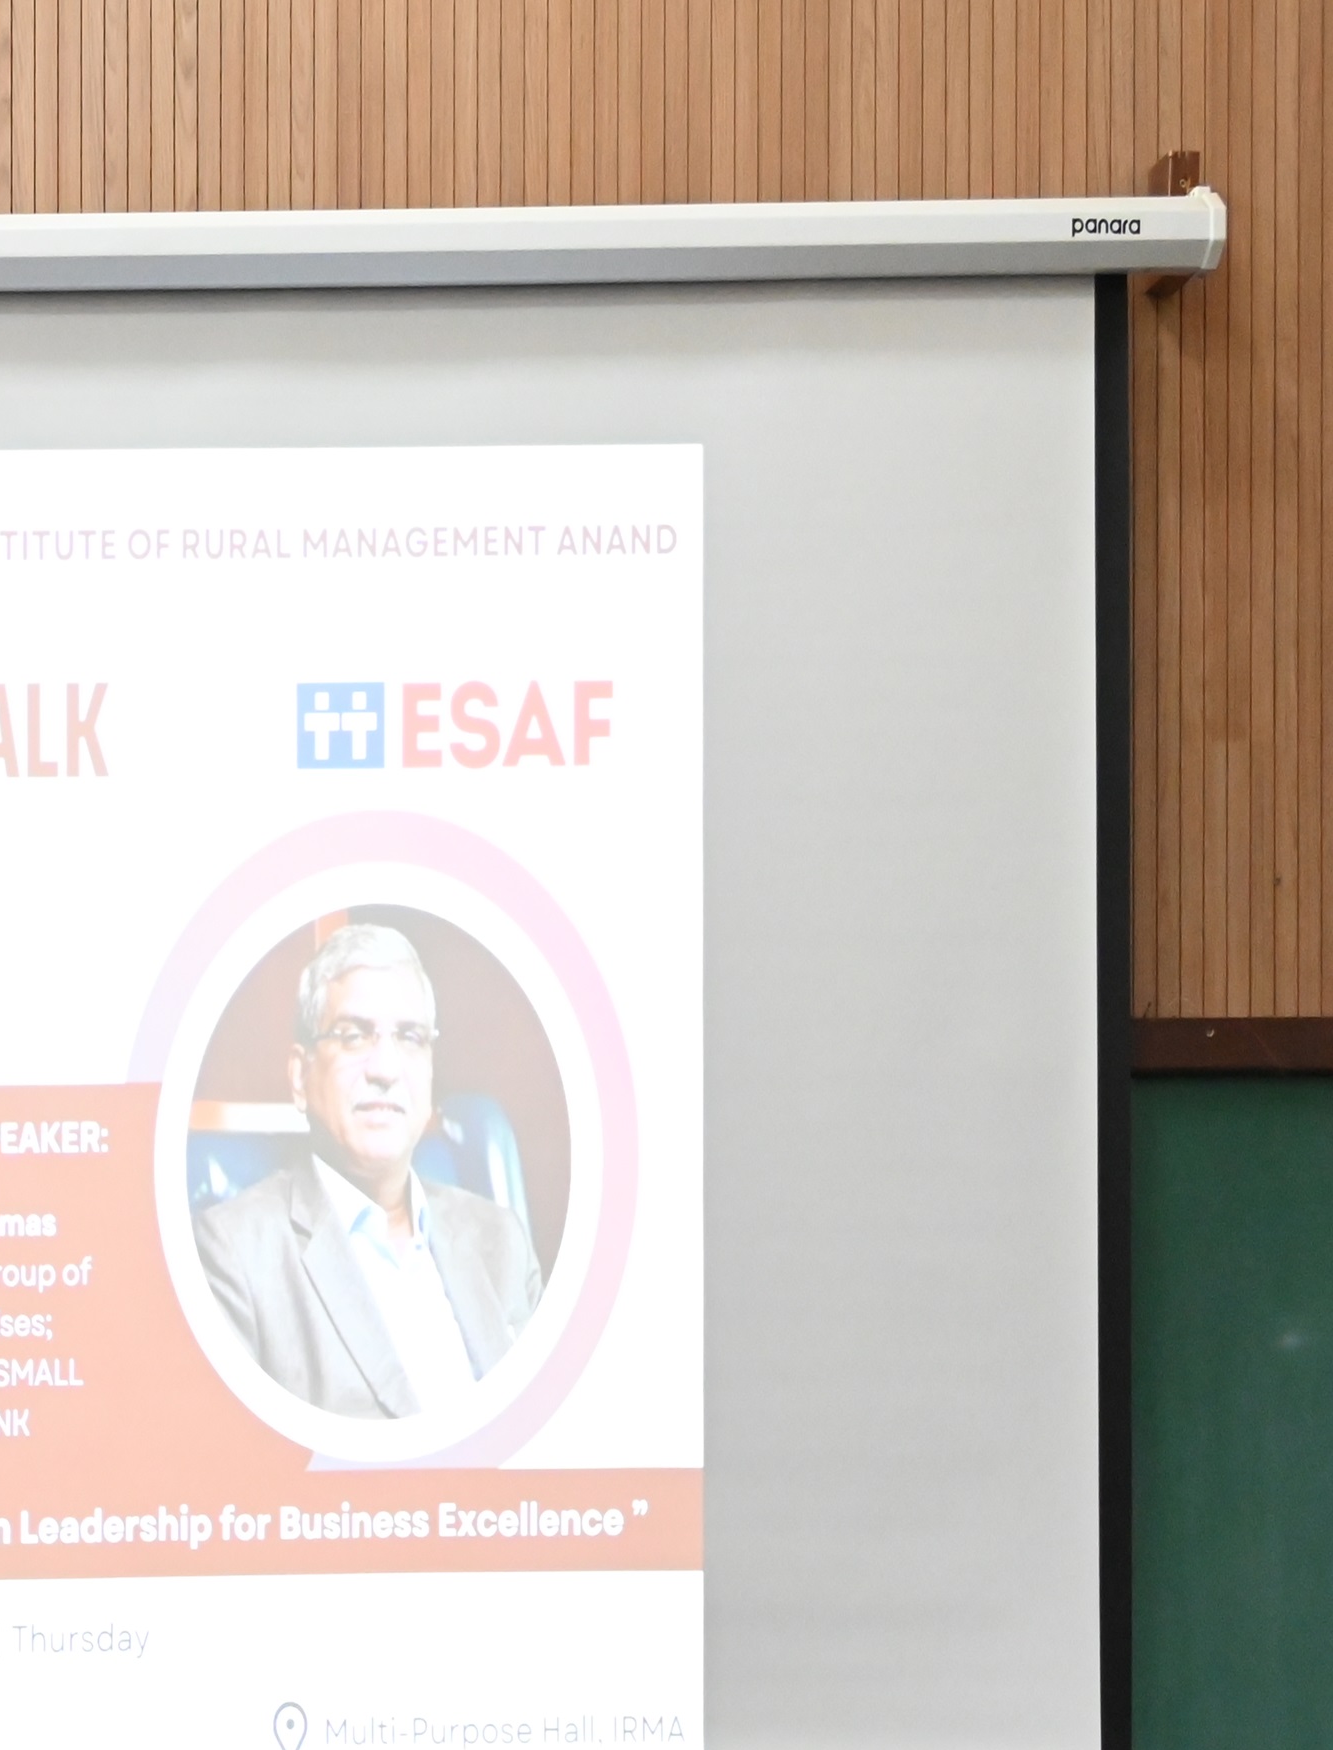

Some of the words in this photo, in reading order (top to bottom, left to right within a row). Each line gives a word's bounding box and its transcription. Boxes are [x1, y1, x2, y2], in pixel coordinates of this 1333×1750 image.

[1072, 218, 1141, 237] panara
[128, 529, 169, 559] OF
[183, 529, 291, 559] RURAL
[303, 526, 546, 558] MANAGEMENT
[557, 524, 677, 555] ANAND
[402, 681, 613, 769] ESAF
[62, 1256, 92, 1286] of
[20, 1504, 212, 1550] Leadership
[219, 1504, 271, 1541] for
[280, 1501, 429, 1540] Business
[13, 1624, 149, 1658] Thursday
[326, 1717, 531, 1749] Multi-Purpose
[612, 1714, 685, 1743] IRMA
